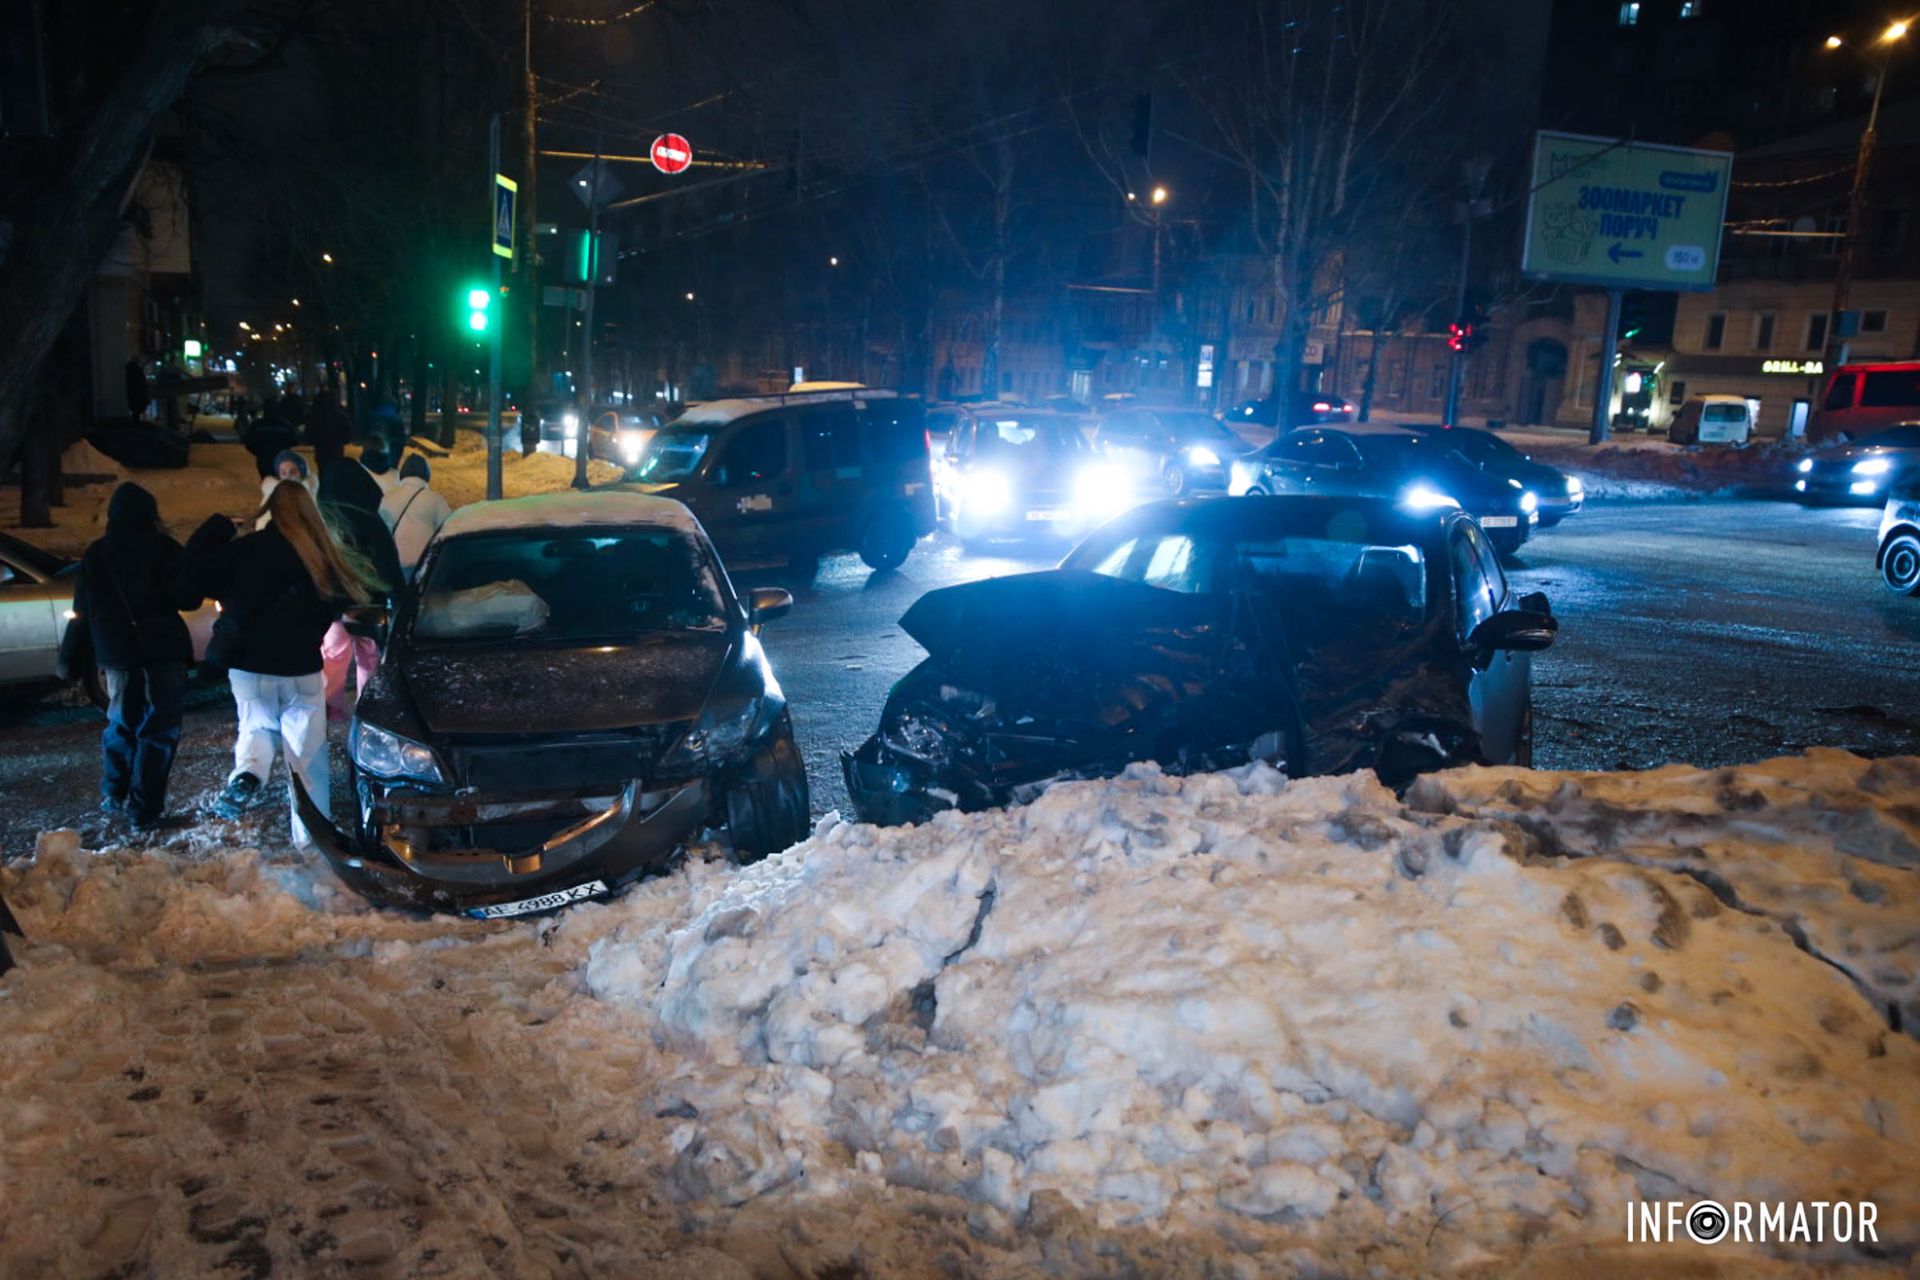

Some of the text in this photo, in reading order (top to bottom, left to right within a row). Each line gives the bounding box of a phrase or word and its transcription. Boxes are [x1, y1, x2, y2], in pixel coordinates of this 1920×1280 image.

[1578, 185, 1686, 219] ЗООМАРКЕТ
[1599, 213, 1659, 240] ПОРУЧ
[567, 883, 600, 900] KX
